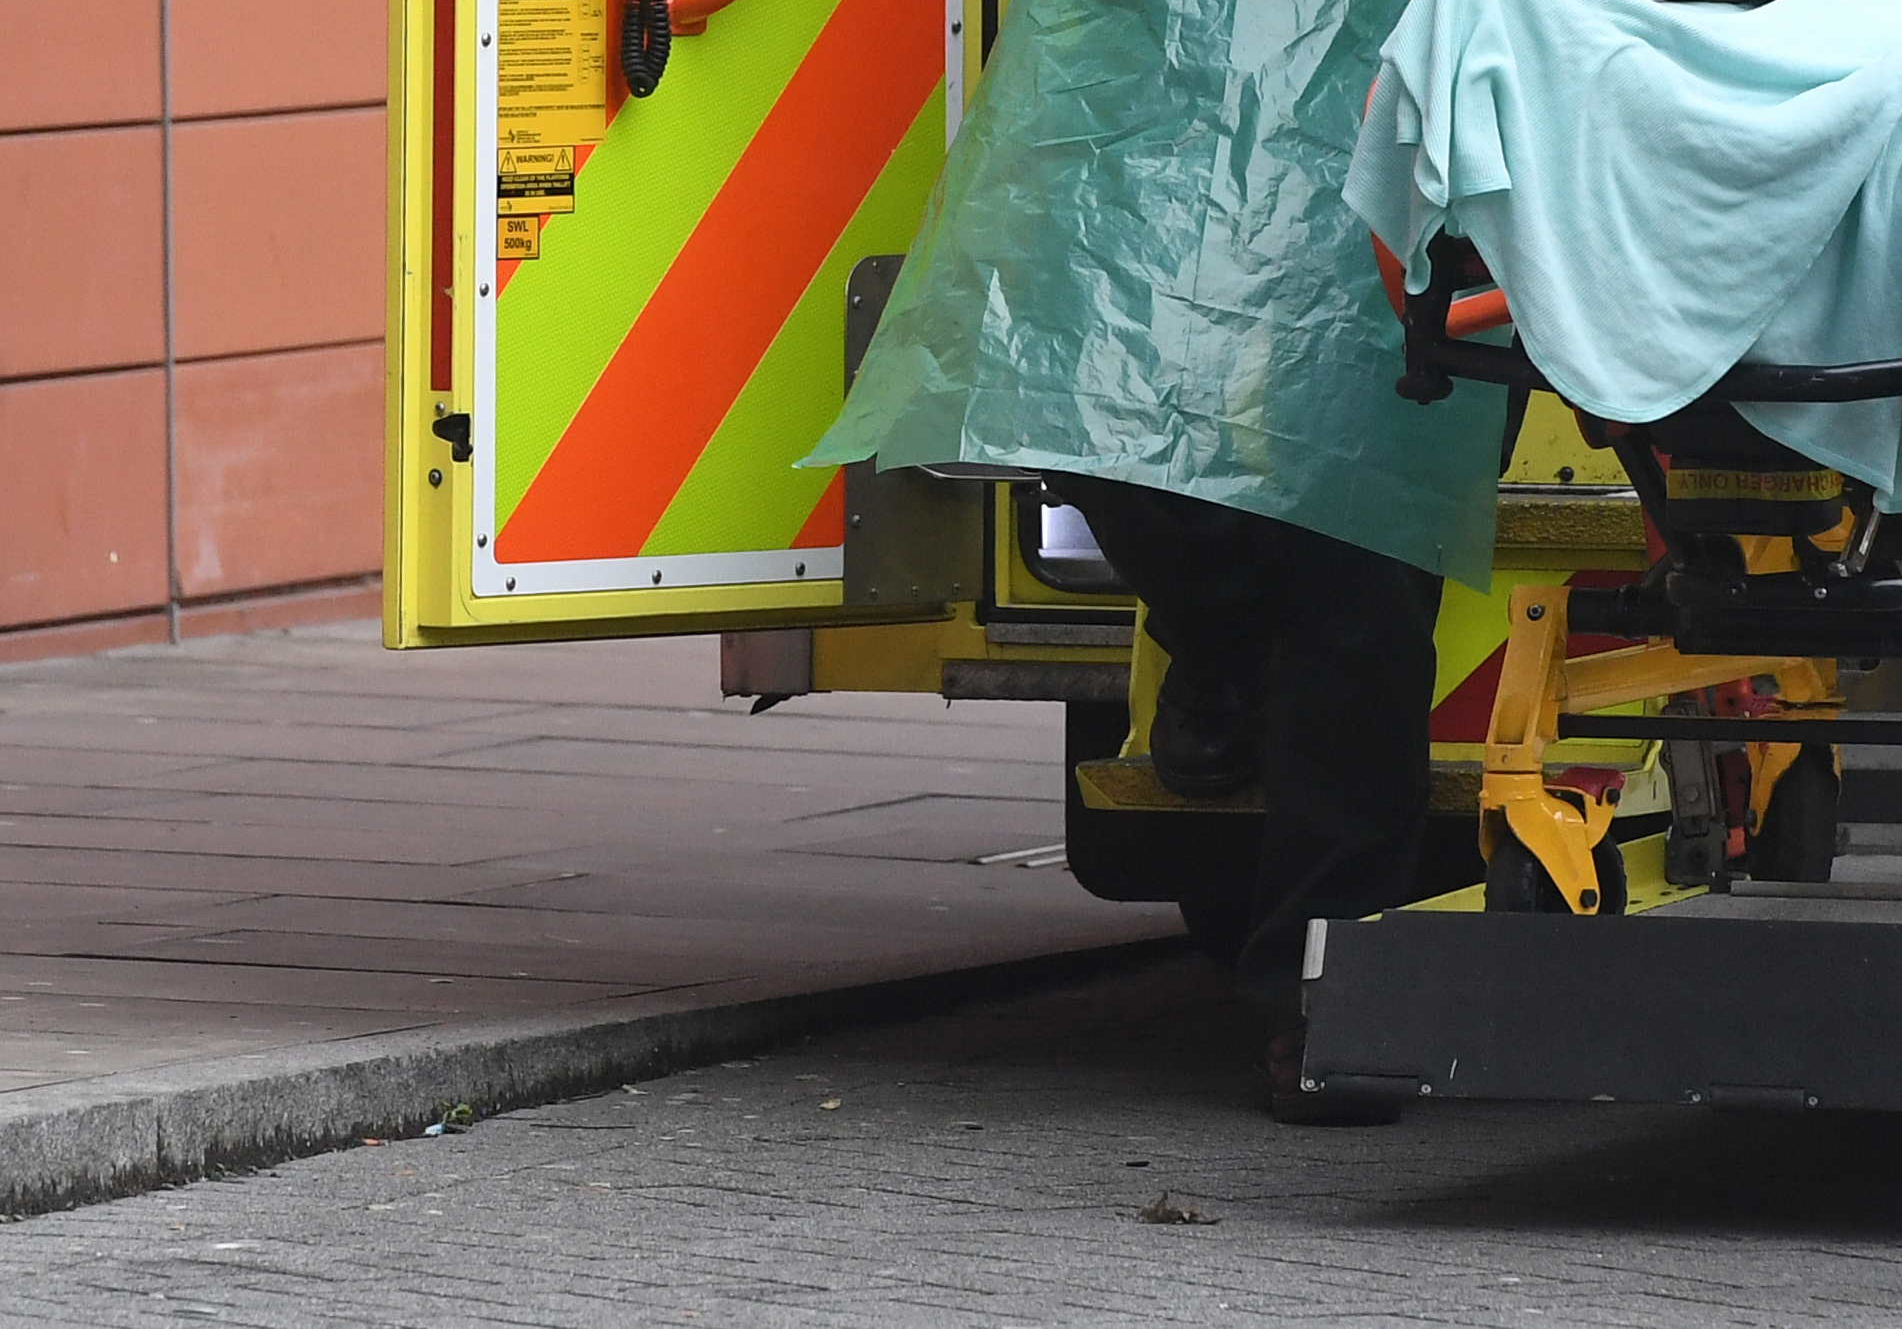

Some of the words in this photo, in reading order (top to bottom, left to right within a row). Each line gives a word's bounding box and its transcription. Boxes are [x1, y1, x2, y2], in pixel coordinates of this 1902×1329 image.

[516, 154, 554, 164] WARNING!
[507, 220, 529, 232] SWL
[504, 237, 532, 252] 500kg
[1679, 472, 1728, 490] ONLY
